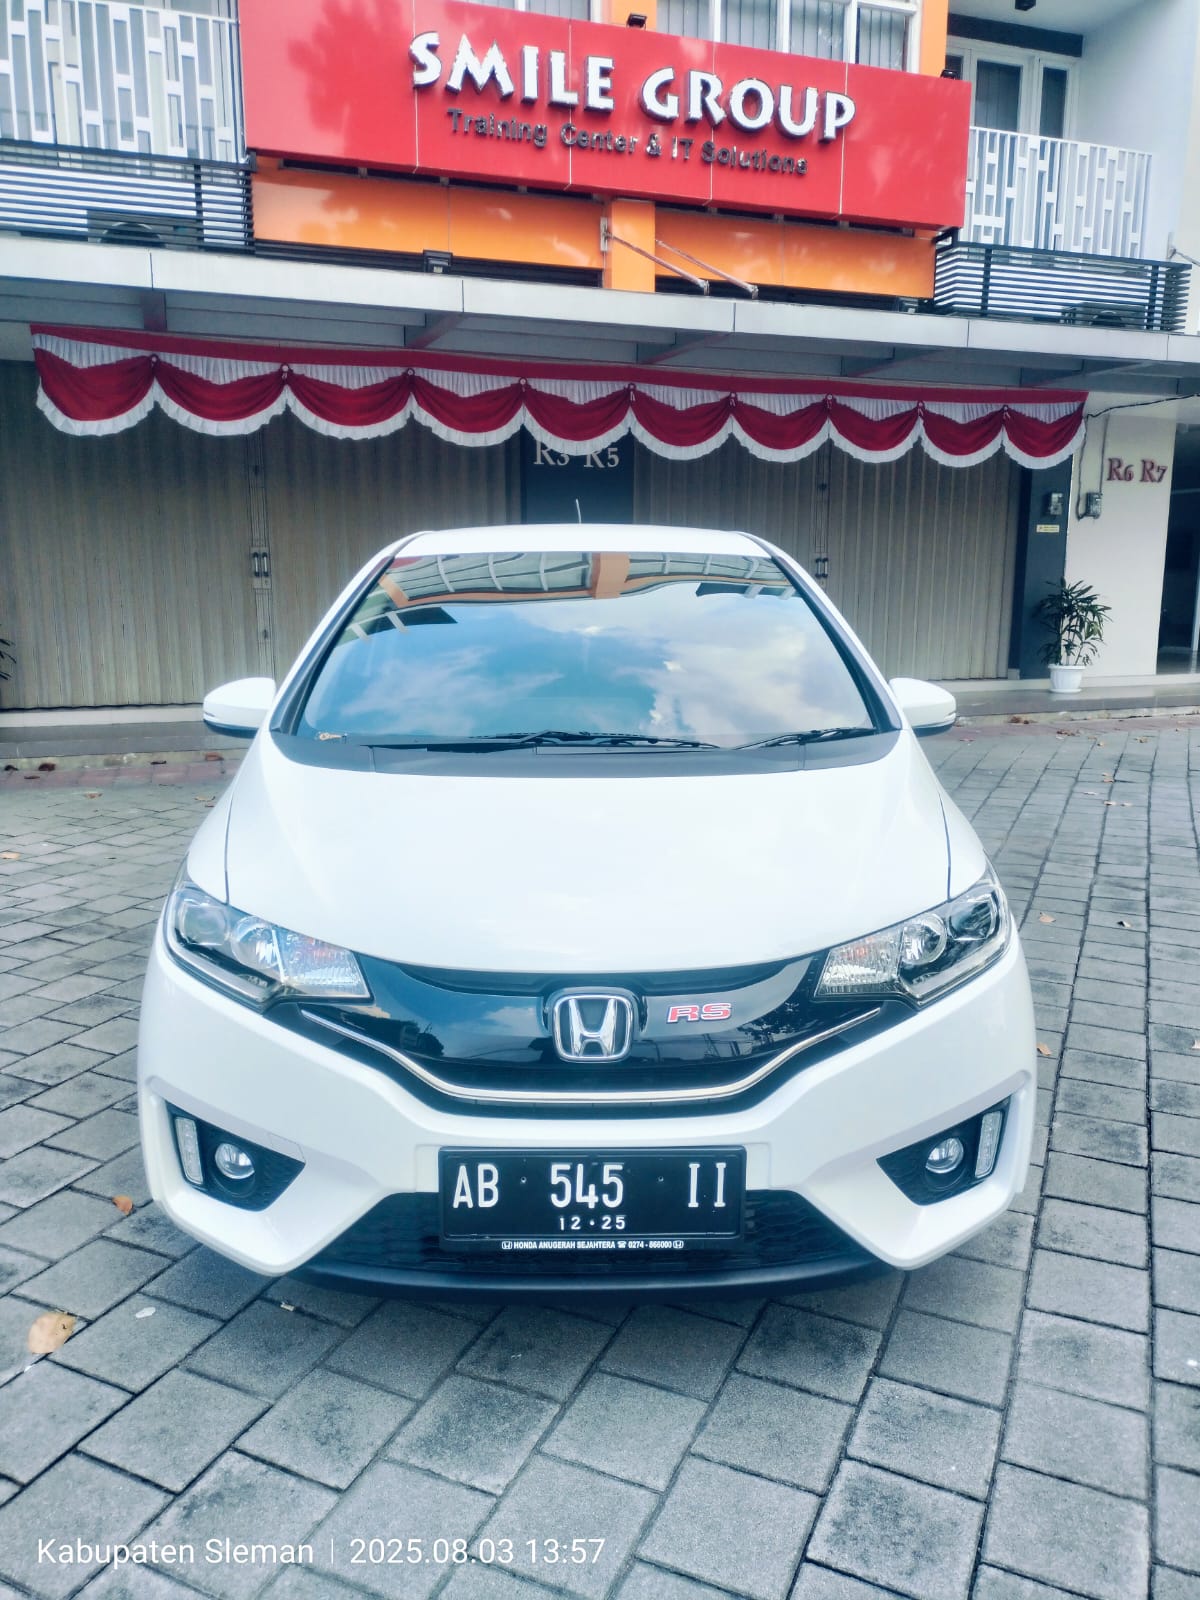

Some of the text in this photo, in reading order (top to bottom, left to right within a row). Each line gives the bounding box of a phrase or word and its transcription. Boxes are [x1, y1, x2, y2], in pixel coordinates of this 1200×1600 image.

[409, 30, 856, 144] SMILE GROUP
[447, 107, 807, 174] Training Center & IT Solutions
[1106, 457, 1168, 483] R6 R7
[666, 1003, 732, 1023] RS
[452, 1162, 726, 1209] AB 545 II
[513, 1240, 538, 1249] HONDA
[538, 1240, 576, 1249] ANUGERAH
[576, 1240, 616, 1249] SEJAHTERA
[628, 1240, 645, 1249] 0274
